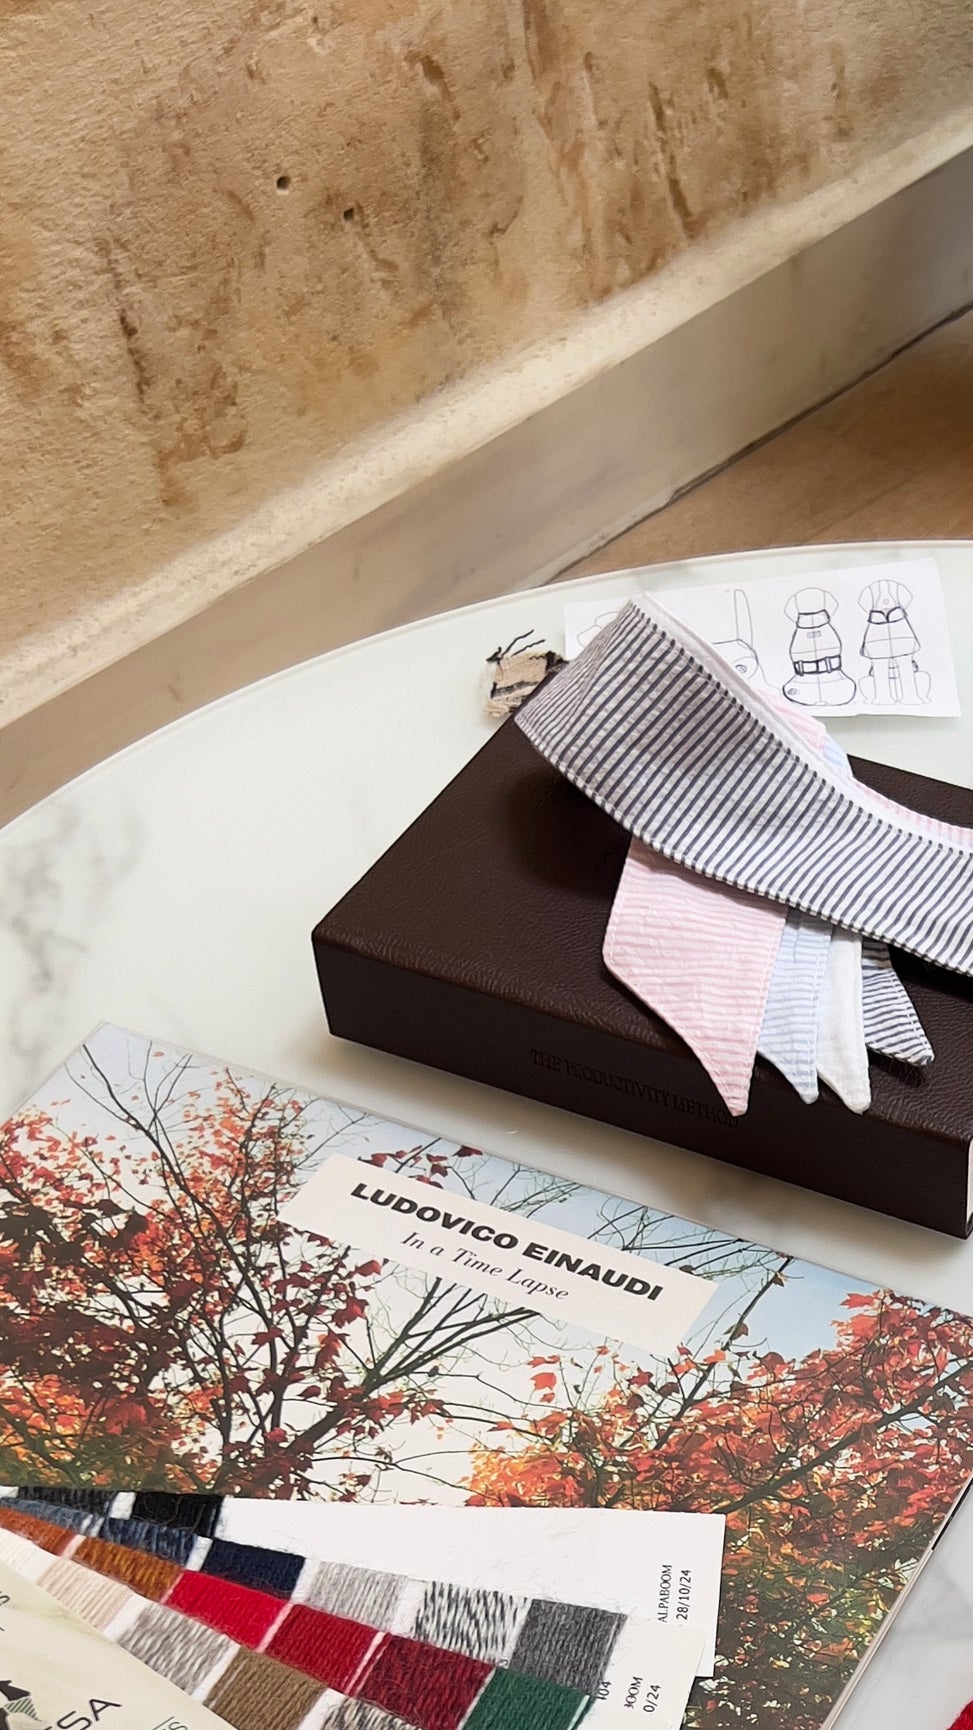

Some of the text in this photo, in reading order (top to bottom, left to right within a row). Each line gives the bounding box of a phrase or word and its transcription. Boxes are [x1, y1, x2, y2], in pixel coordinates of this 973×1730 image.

[530, 1049, 562, 1072] THE
[350, 1182, 664, 1301] LUDOVICO EINAUDI
[400, 1231, 570, 1301] In a Time Lapse
[657, 1564, 673, 1623] ALPABOOM
[676, 1569, 692, 1621] 28/10/24
